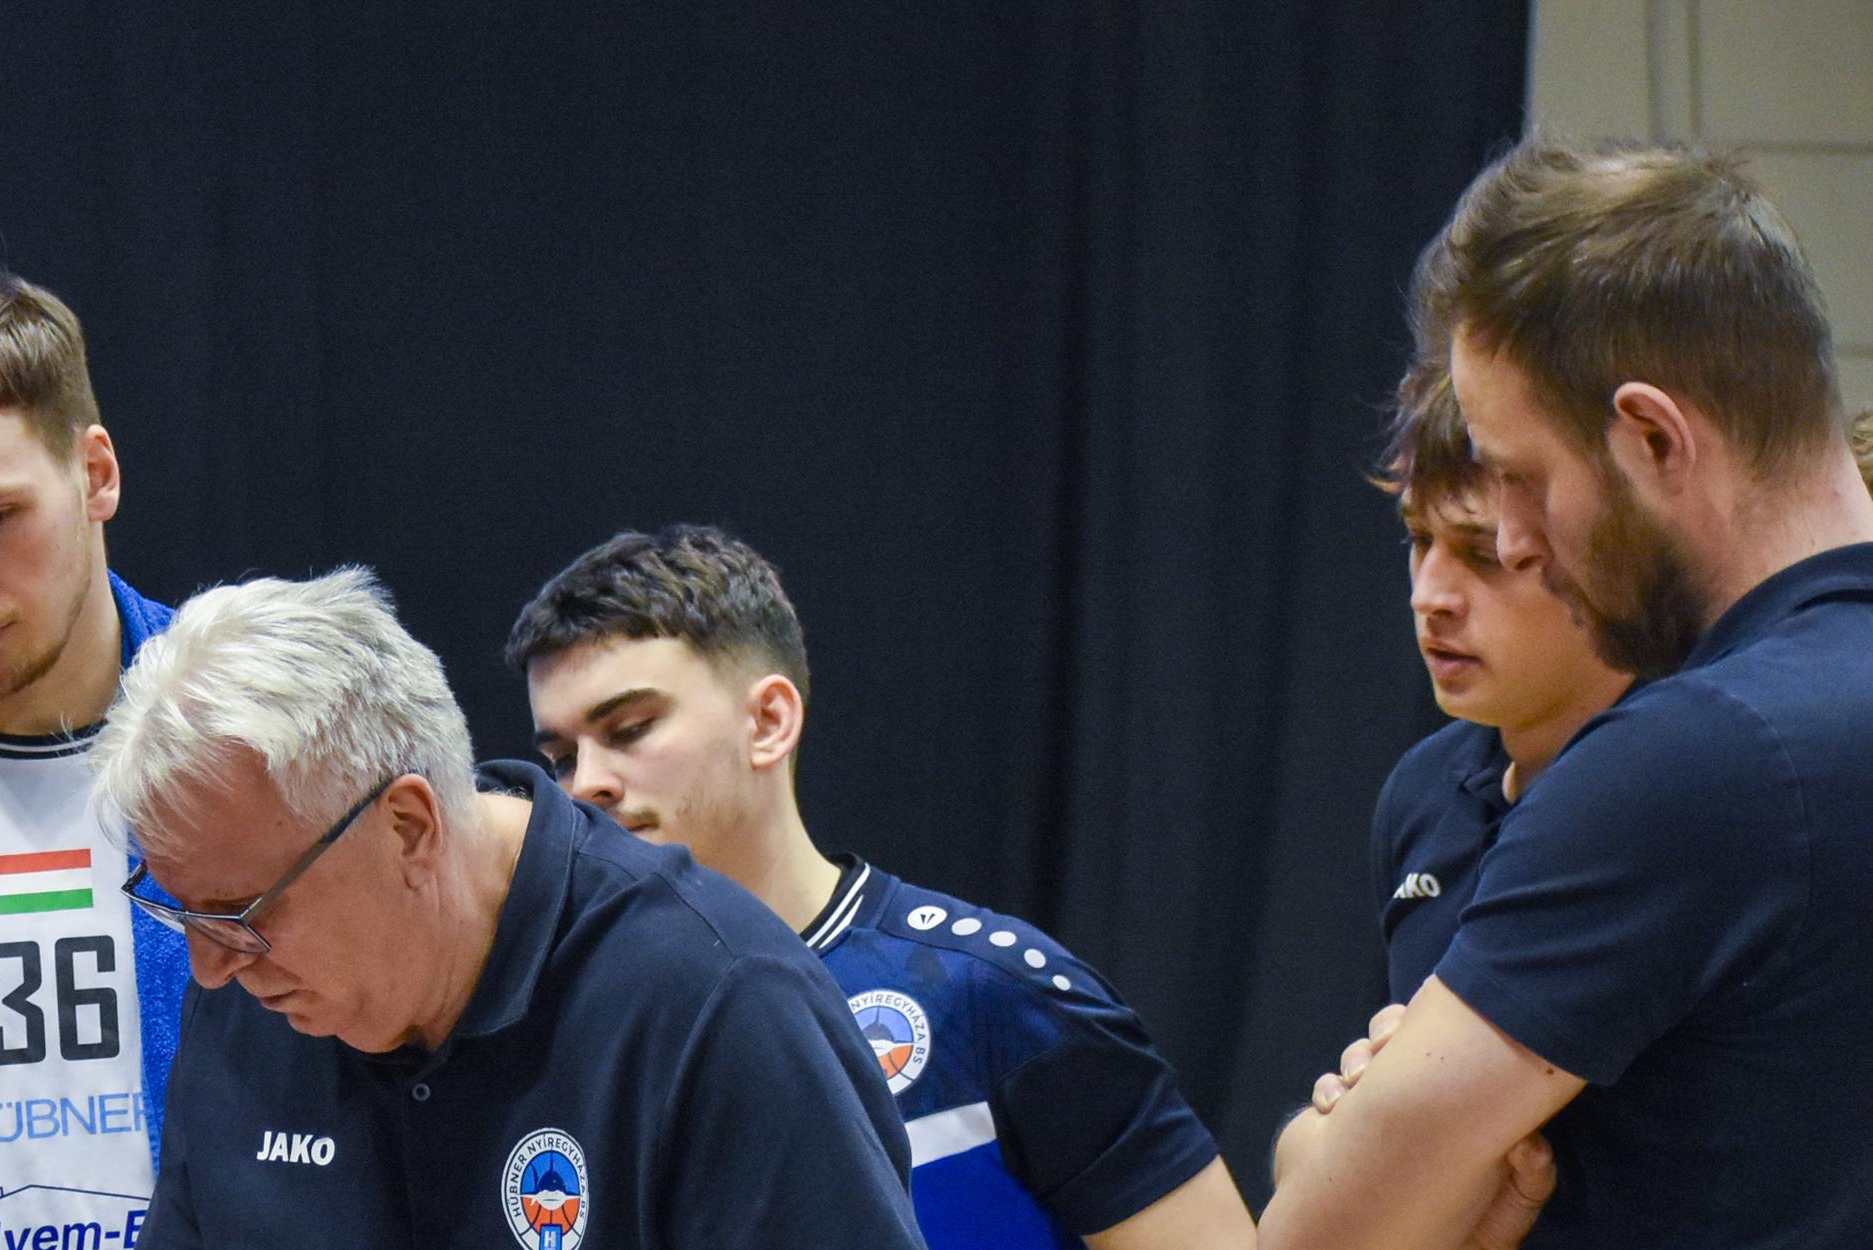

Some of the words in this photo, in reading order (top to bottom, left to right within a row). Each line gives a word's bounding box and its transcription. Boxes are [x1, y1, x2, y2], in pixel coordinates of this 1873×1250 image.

[1392, 873, 1442, 899] AKO
[912, 1045, 926, 1065] BS
[256, 1130, 336, 1166] JAKO
